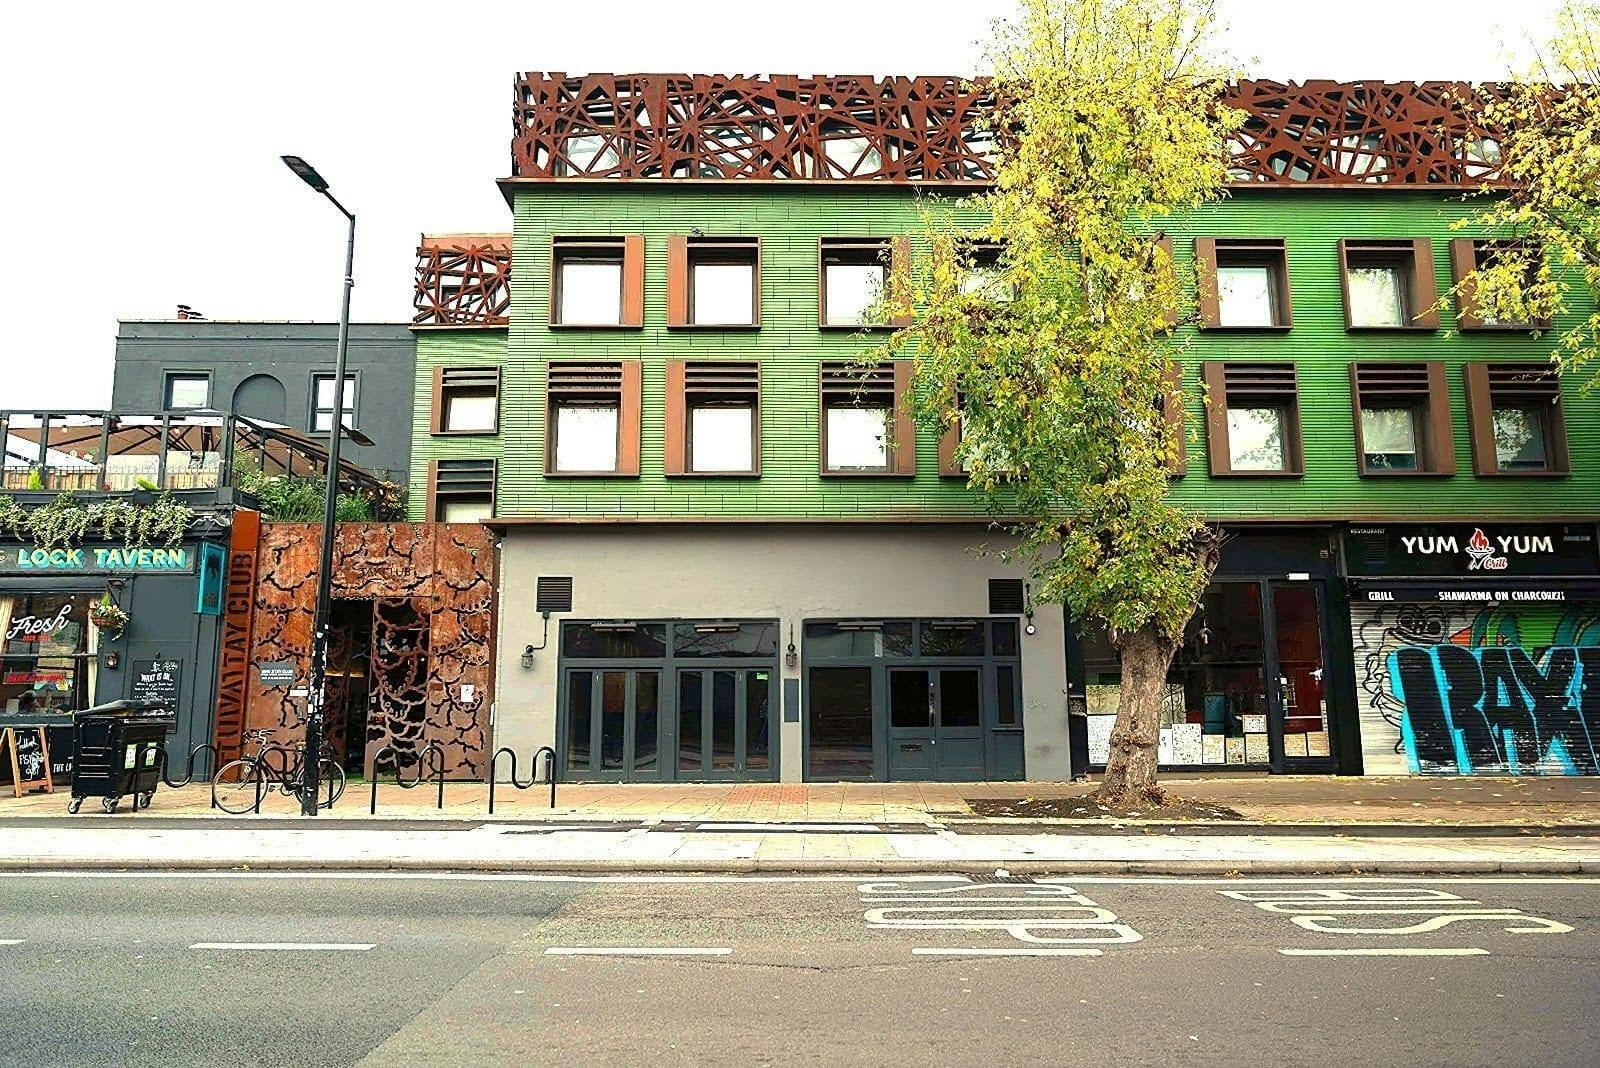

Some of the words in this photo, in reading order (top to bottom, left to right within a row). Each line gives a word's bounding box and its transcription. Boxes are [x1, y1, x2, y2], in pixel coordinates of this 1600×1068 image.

[1401, 535, 1459, 554] YUM
[1497, 535, 1554, 554] YUM
[18, 548, 83, 569] LOCK
[94, 548, 186, 569] TAVERN
[1484, 557, 1508, 569] Grill
[227, 553, 253, 614] CLUB
[1368, 591, 1394, 600] GRILL
[1438, 591, 1492, 600] SHAWARMA
[1494, 591, 1509, 600] ON
[6, 604, 72, 639] Fresh
